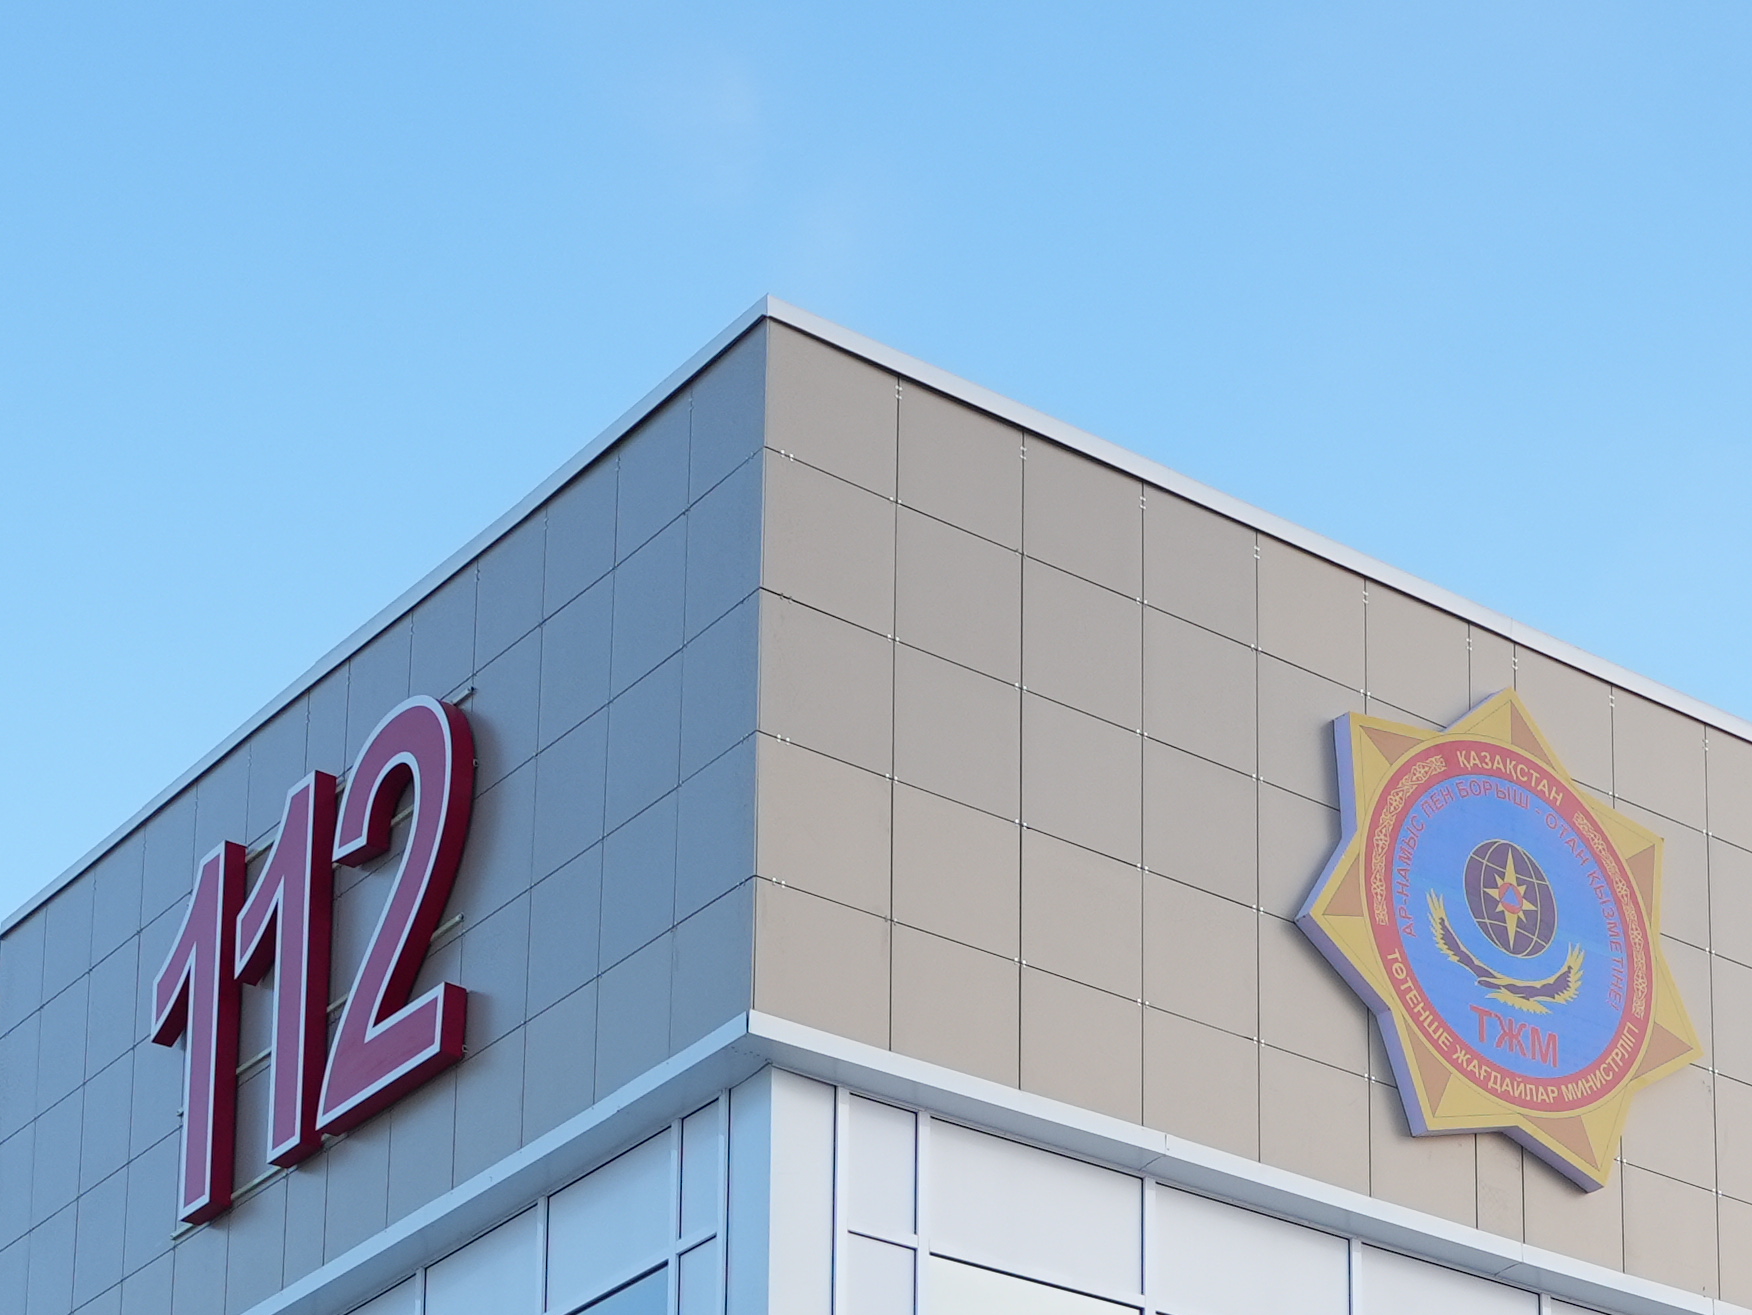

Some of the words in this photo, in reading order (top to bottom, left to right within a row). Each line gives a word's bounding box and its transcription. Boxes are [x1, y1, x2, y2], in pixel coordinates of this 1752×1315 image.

[1457, 750, 1564, 807] ҚАЗАҚСТАН
[1395, 814, 1426, 938] АР-НАМЫС
[1421, 786, 1456, 820] ПЕН
[1457, 779, 1530, 811] БОРЫШ
[1545, 812, 1590, 868] ОТАН
[151, 694, 475, 1226] 112
[1386, 948, 1452, 1053] ТӨТЕНШЕ
[1452, 1046, 1559, 1104] ЖАҒДАЙЛАР
[1562, 1021, 1640, 1102] МИНИСТРЛІГІ
[1469, 1003, 1560, 1068] ТЖМ
